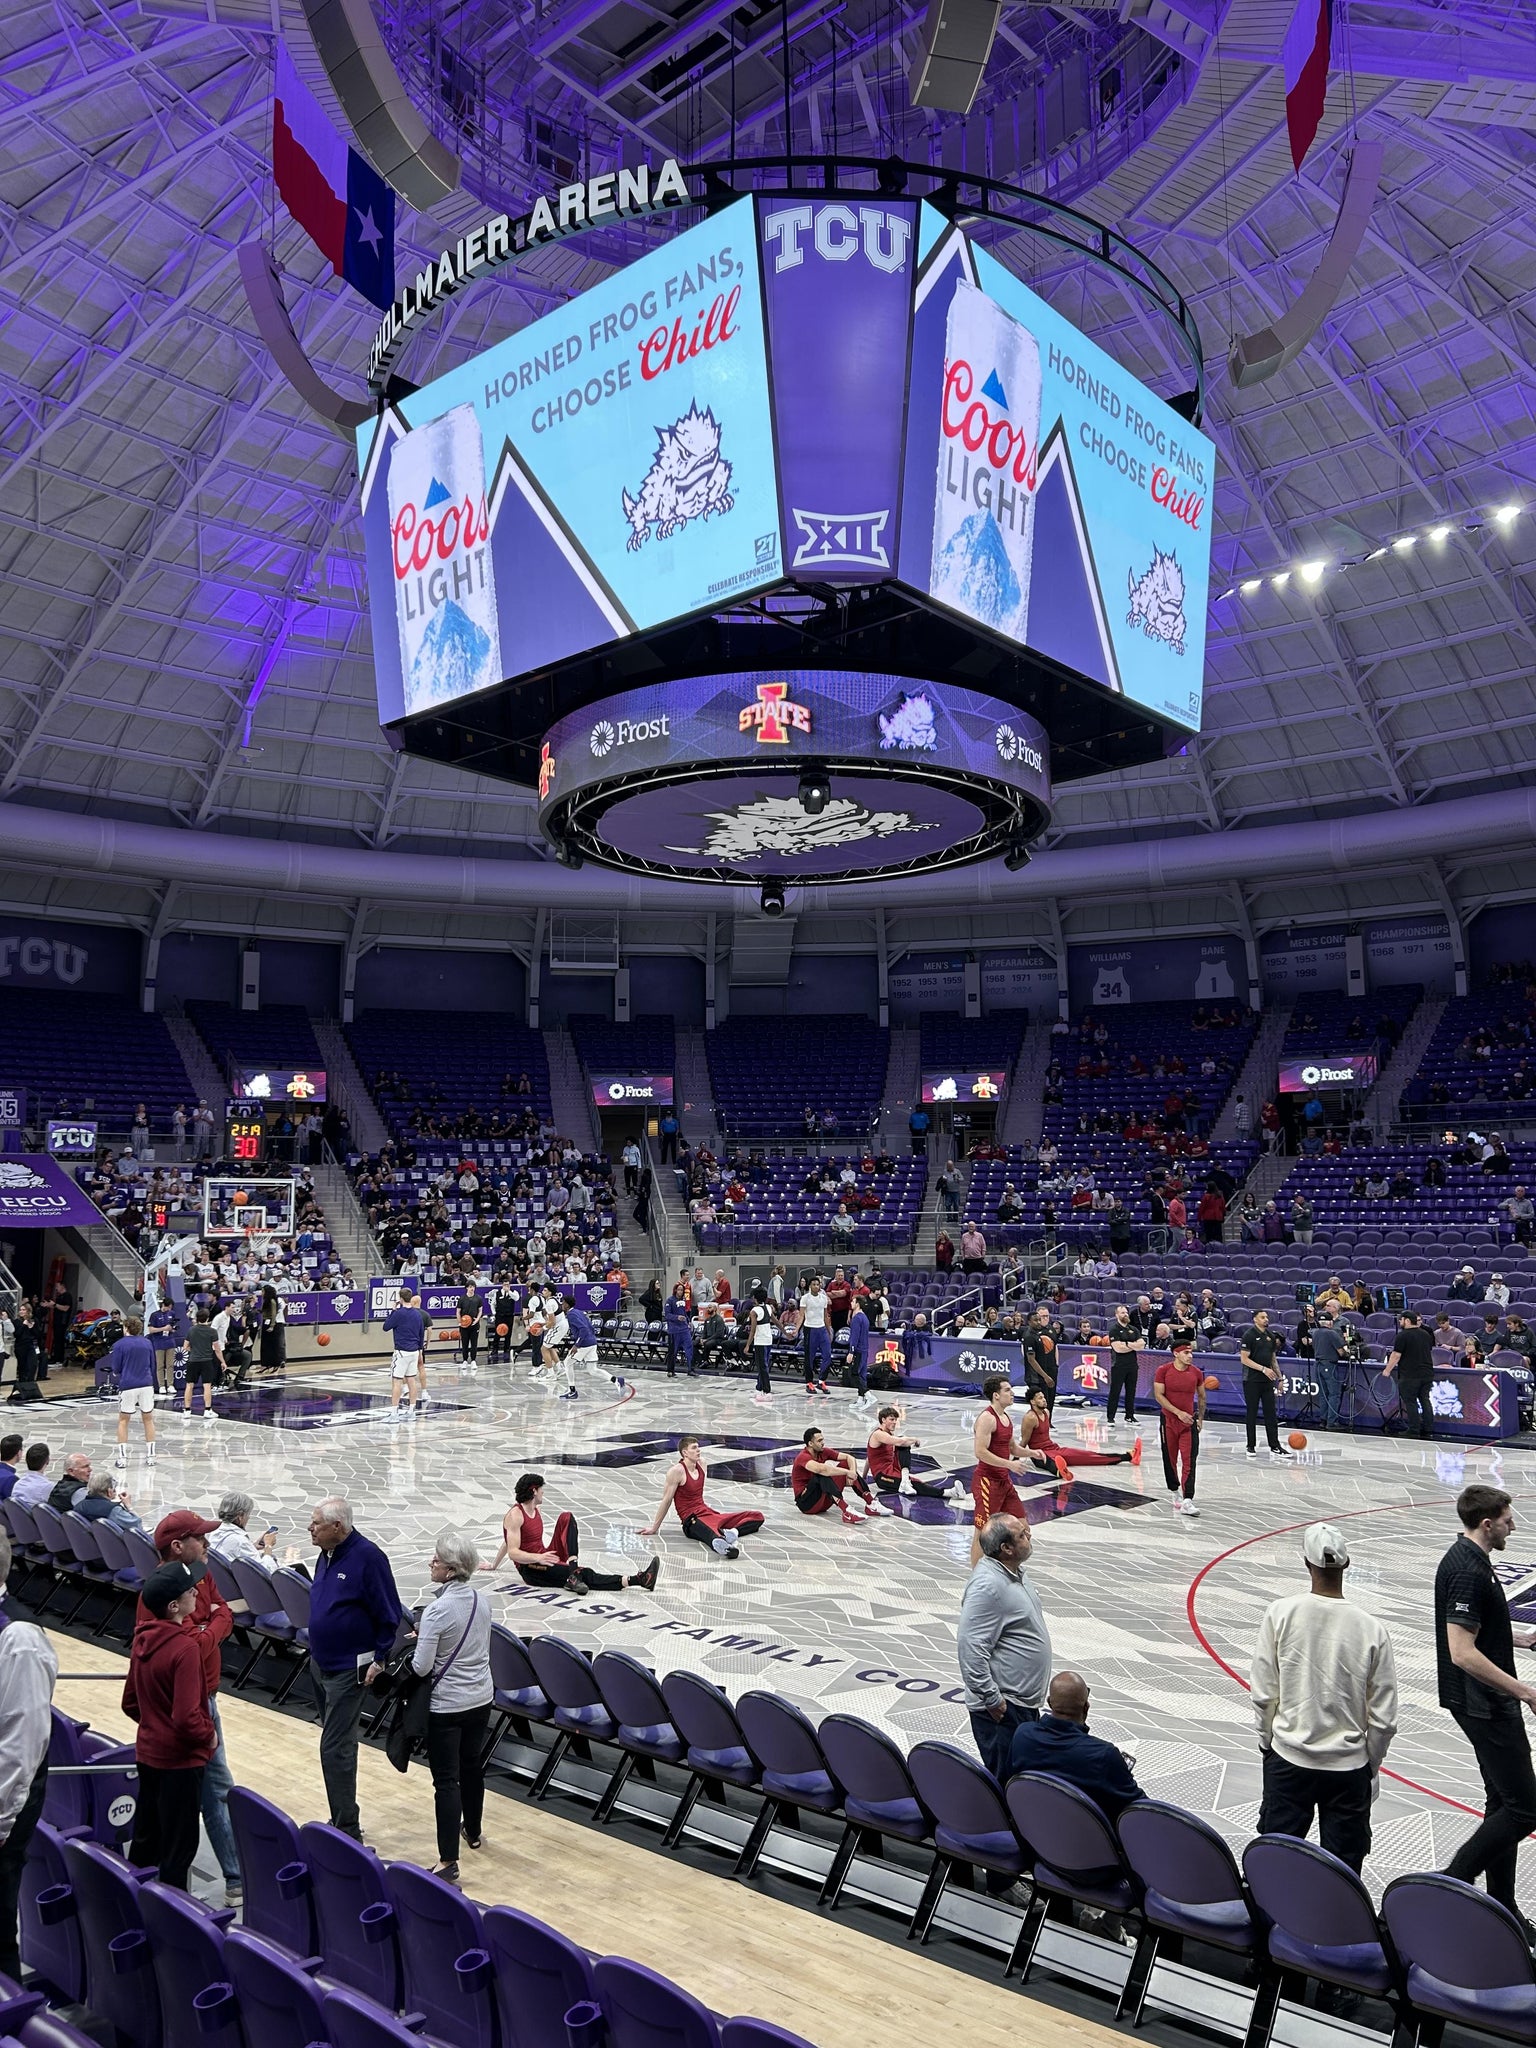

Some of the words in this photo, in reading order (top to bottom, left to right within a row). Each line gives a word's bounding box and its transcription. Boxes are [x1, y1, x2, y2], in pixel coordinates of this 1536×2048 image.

[527, 159, 689, 241] ARENA
[765, 205, 911, 274] TCU
[484, 334, 582, 409] HORNED
[590, 291, 657, 351] FROG
[666, 246, 744, 309] FANS,
[531, 360, 632, 434] CHOOSE
[638, 284, 741, 382] Chill
[941, 358, 1039, 493] Coors
[1048, 343, 1122, 419] HORNED
[1125, 403, 1167, 454] FROG
[1169, 440, 1208, 495] FANS,
[1079, 421, 1148, 489] CHOOSE
[1151, 462, 1205, 531] Chill
[945, 445, 1031, 537] LIGHT
[393, 490, 489, 580] Coors
[756, 535, 774, 556] 21
[404, 547, 487, 622] LIGHT
[707, 575, 739, 594] CELEBRATE
[738, 700, 812, 734] STATE
[616, 713, 670, 746] Frost
[1018, 737, 1043, 774] Frost
[1371, 924, 1449, 940] CHAMPIONSHIPS
[1201, 946, 1226, 956] BANE
[1289, 937, 1319, 948] MEN'S
[1371, 946, 1394, 957] 1968
[1402, 945, 1425, 954] 1971
[1434, 942, 1453, 951] 198
[0, 936, 89, 985] TCU
[984, 957, 1045, 968] APPEARANCES
[1089, 952, 1132, 962] WILLIAMS
[1265, 957, 1288, 967] 1952
[1294, 954, 1317, 964] 1953
[1325, 952, 1347, 961] 1959
[923, 961, 950, 971] MEN'S
[1294, 968, 1317, 978] 1998
[893, 978, 912, 987] 1952
[918, 977, 938, 986] 1953
[943, 976, 963, 985] 1959
[984, 974, 1005, 983] 1968
[1011, 974, 1031, 982] 1971
[1210, 976, 1217, 993] 1
[918, 989, 938, 998] 2018
[1100, 982, 1123, 998] 34
[1320, 1066, 1354, 1081] Frost
[0, 1090, 15, 1098] UNK
[625, 1085, 653, 1098] Frost
[52, 1127, 95, 1149] TCU
[233, 1136, 258, 1158] 30
[287, 1301, 307, 1309] TACO
[287, 1308, 307, 1316] BELL
[373, 1310, 388, 1318] FREE
[875, 1350, 906, 1366] STATE
[977, 1356, 1011, 1373] Frost
[1073, 1364, 1108, 1384] STATE
[1291, 1376, 1320, 1396] Fro
[493, 1583, 649, 1623] WALSH
[650, 1620, 846, 1668] FAMILY
[855, 1668, 968, 1705] COU
[111, 1803, 133, 1819] TCU
